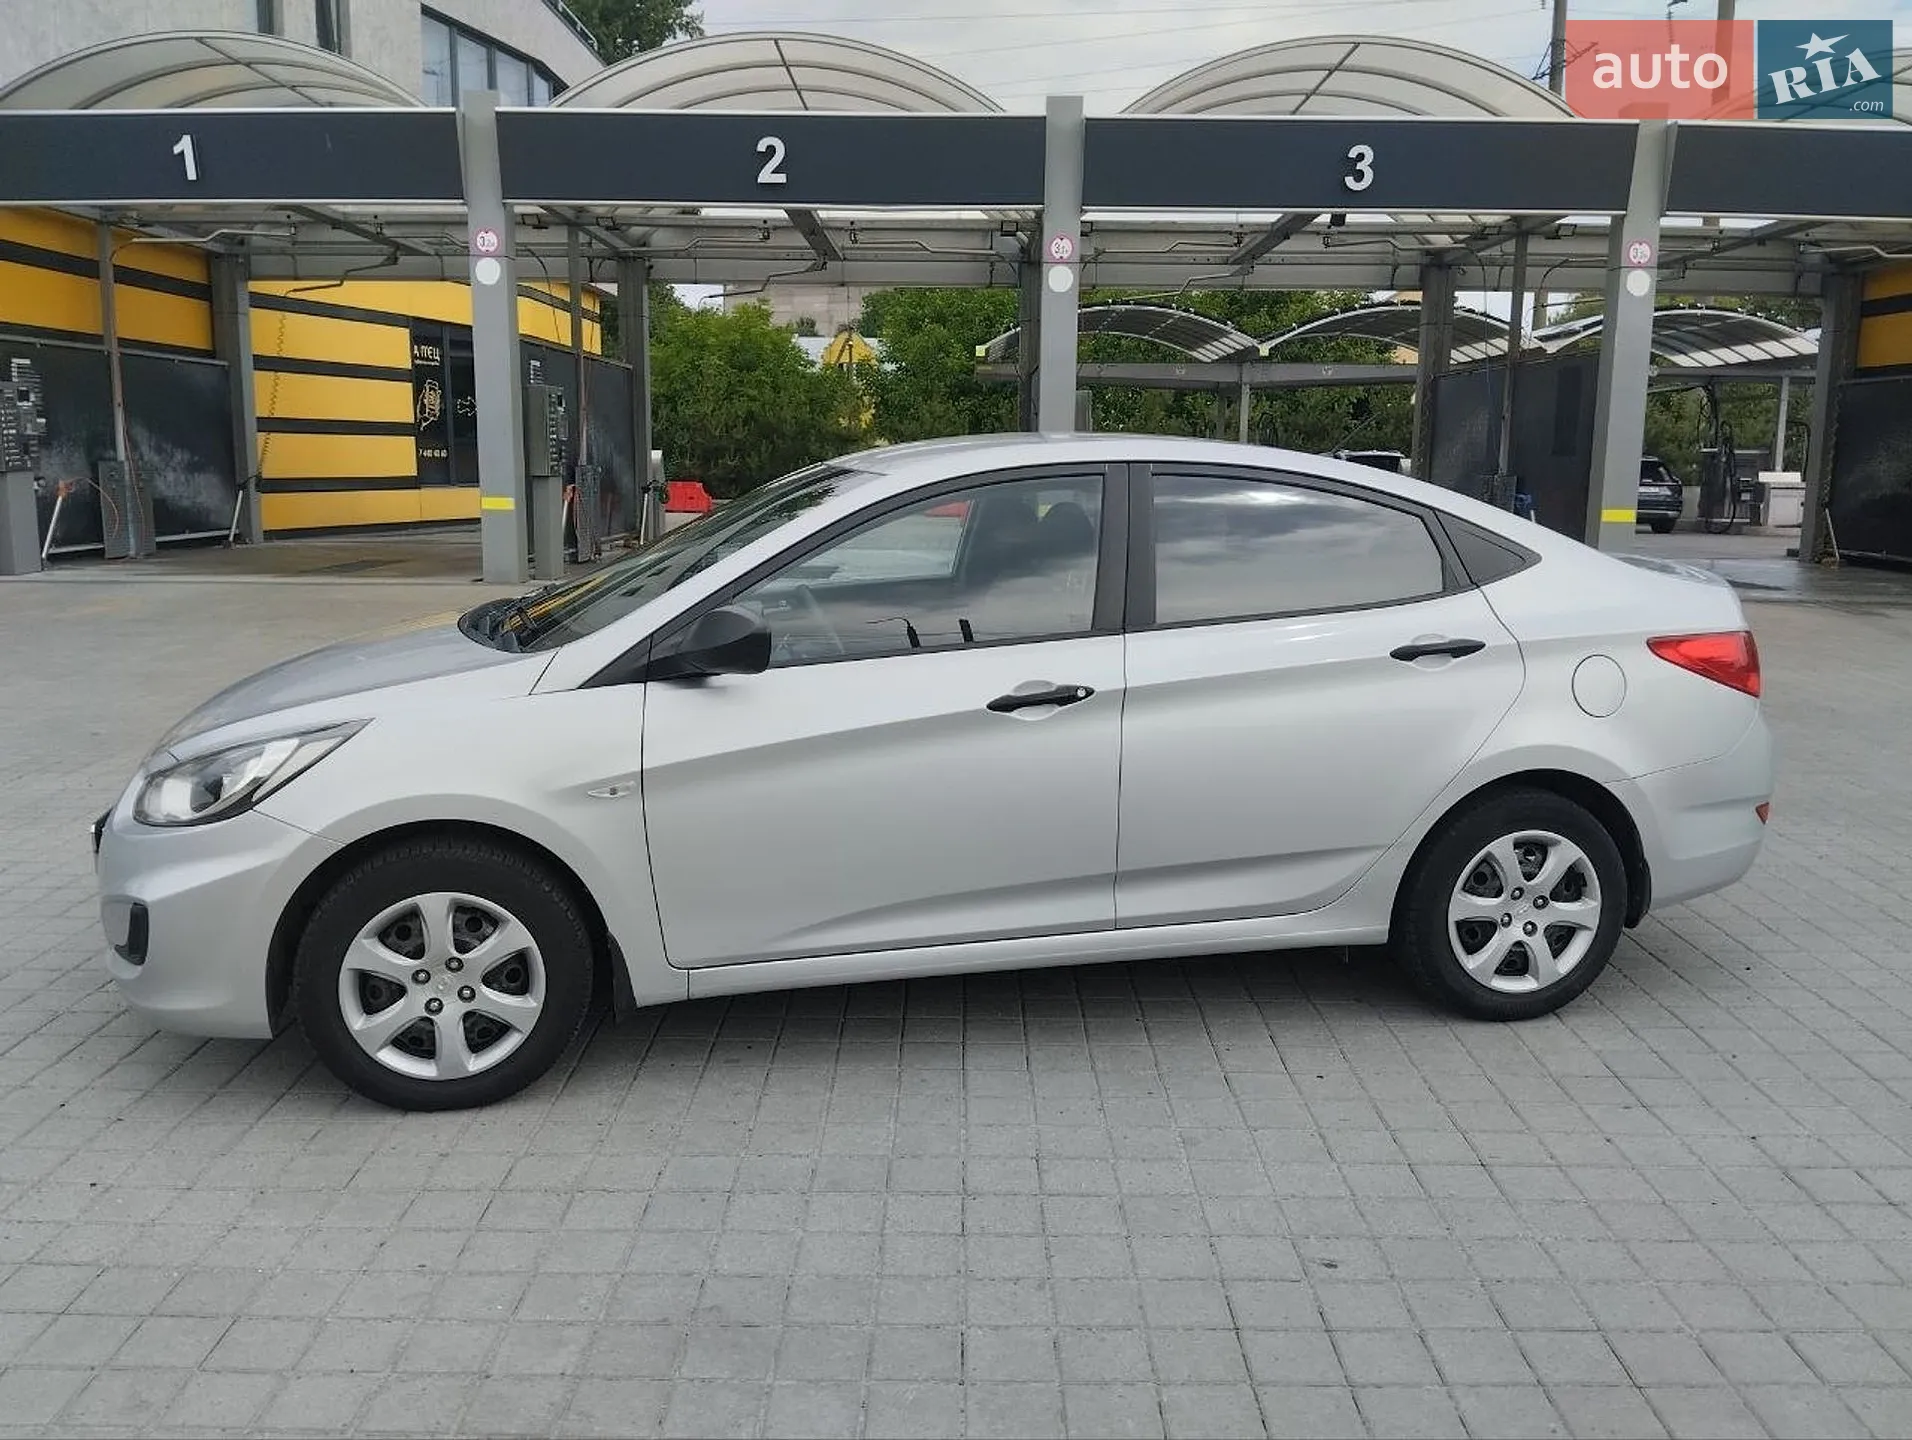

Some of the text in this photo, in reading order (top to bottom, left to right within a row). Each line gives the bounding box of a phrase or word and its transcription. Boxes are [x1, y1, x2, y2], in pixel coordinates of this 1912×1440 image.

[173, 134, 197, 180] 1
[756, 136, 787, 184] 2
[1344, 144, 1374, 191] 3
